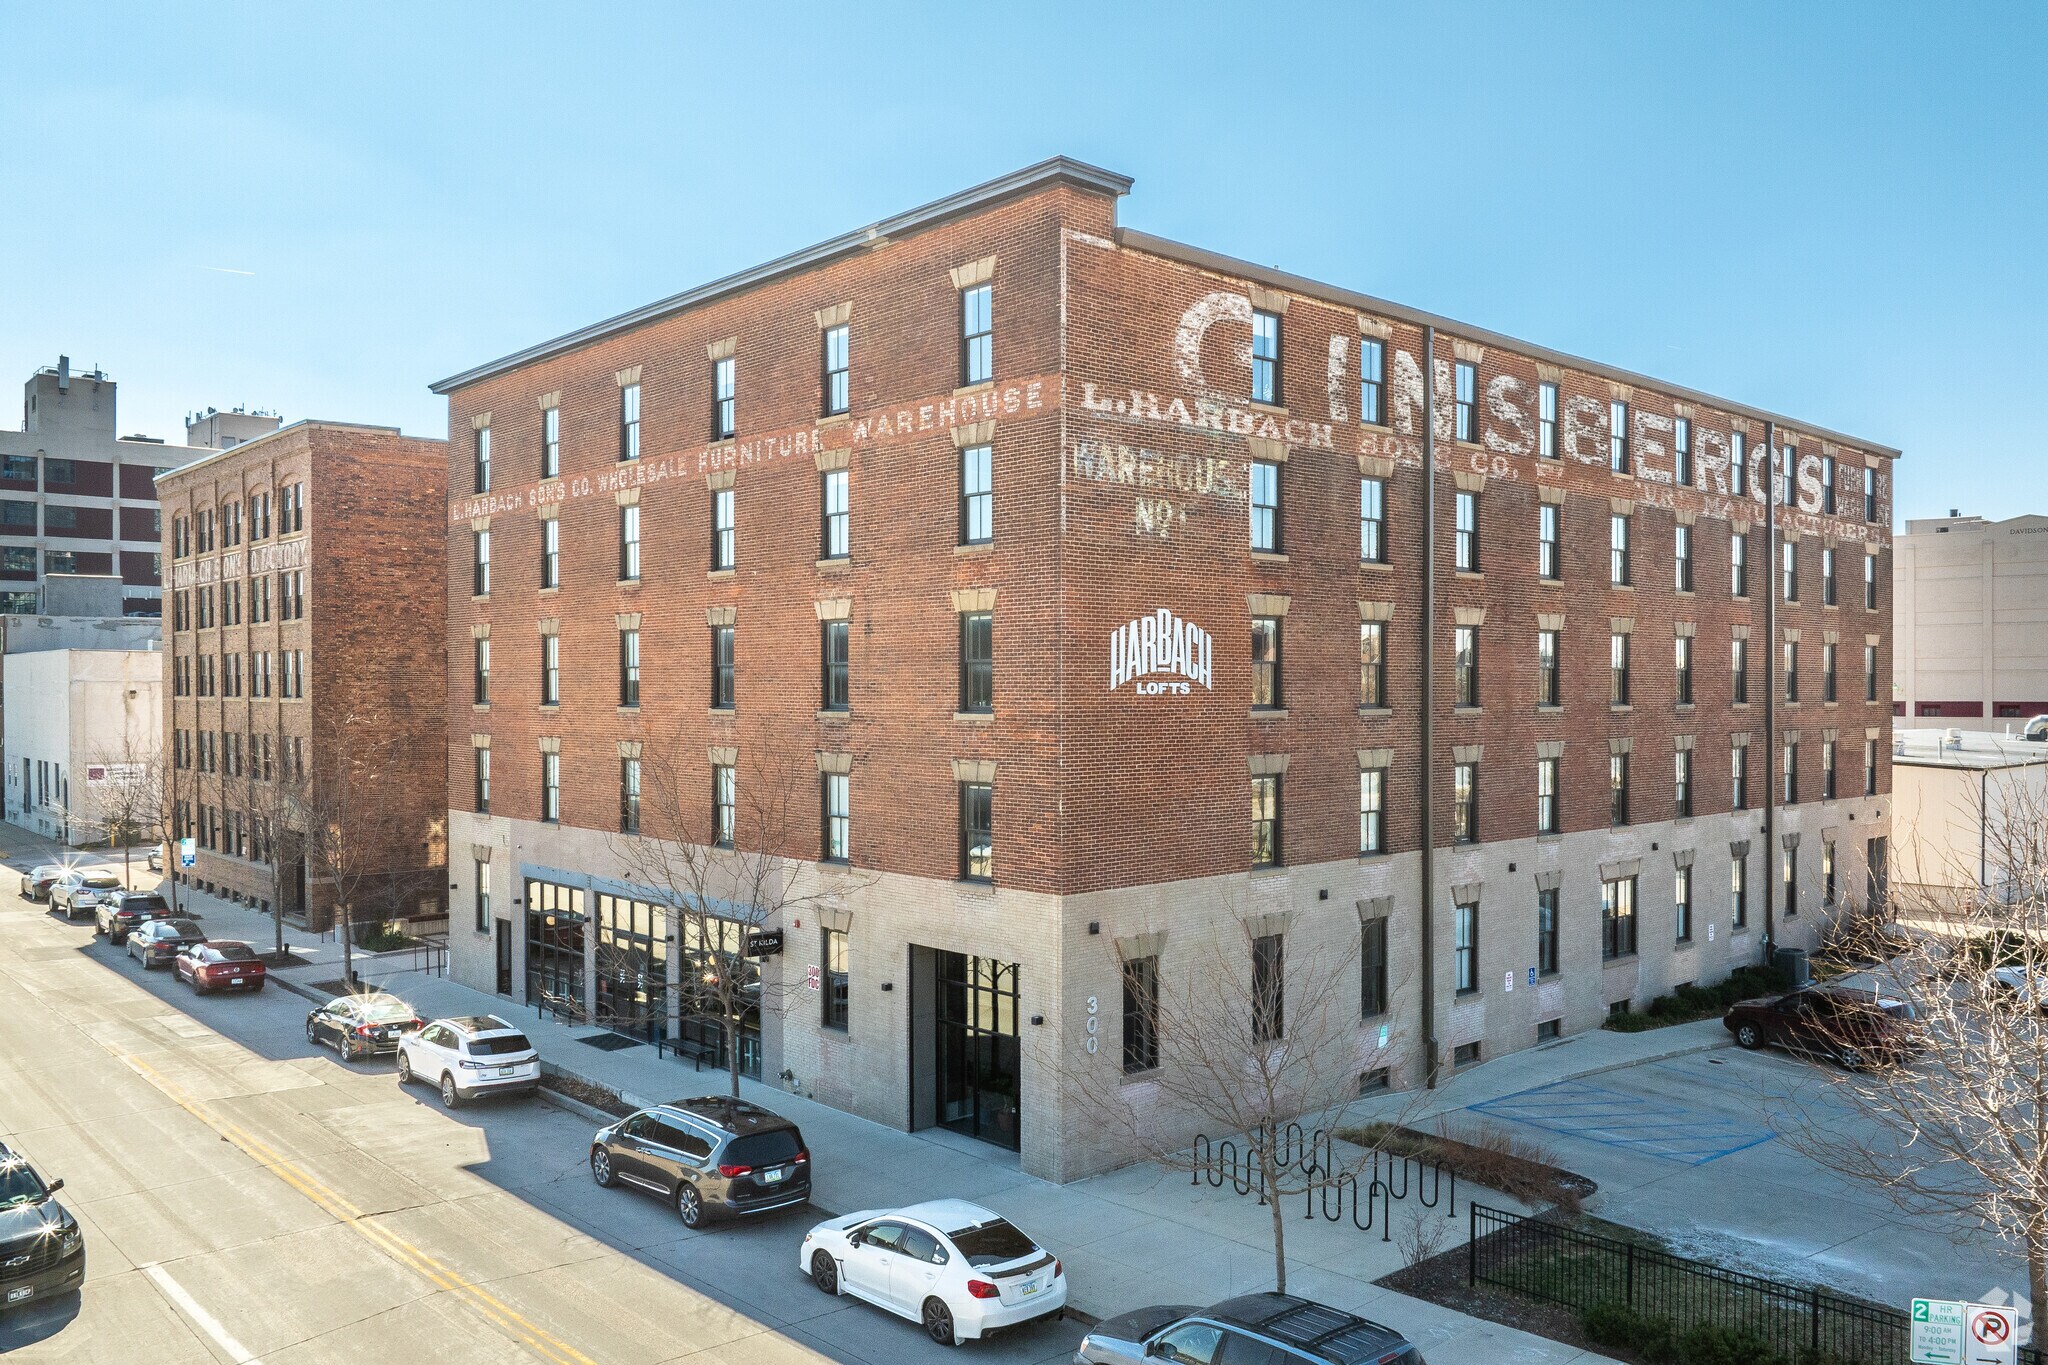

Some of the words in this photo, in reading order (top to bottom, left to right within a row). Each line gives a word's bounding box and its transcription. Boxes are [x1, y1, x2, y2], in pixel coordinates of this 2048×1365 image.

[571, 477, 595, 499] CO.
[597, 456, 688, 492] WHOLESALE
[698, 428, 825, 474] FURNITURE
[851, 381, 1044, 444] WAREHOUSE
[1110, 608, 1212, 691] HARBACH
[1136, 682, 1191, 695] LOFTS
[758, 938, 779, 947] KILDA
[1086, 996, 1099, 1055] 300
[1914, 1303, 1927, 1319] 2
[1939, 1305, 1953, 1314] HR
[1929, 1314, 1961, 1325] PARKING
[1923, 1325, 1942, 1335] 9:00
[1928, 1336, 1947, 1346] 4:00
